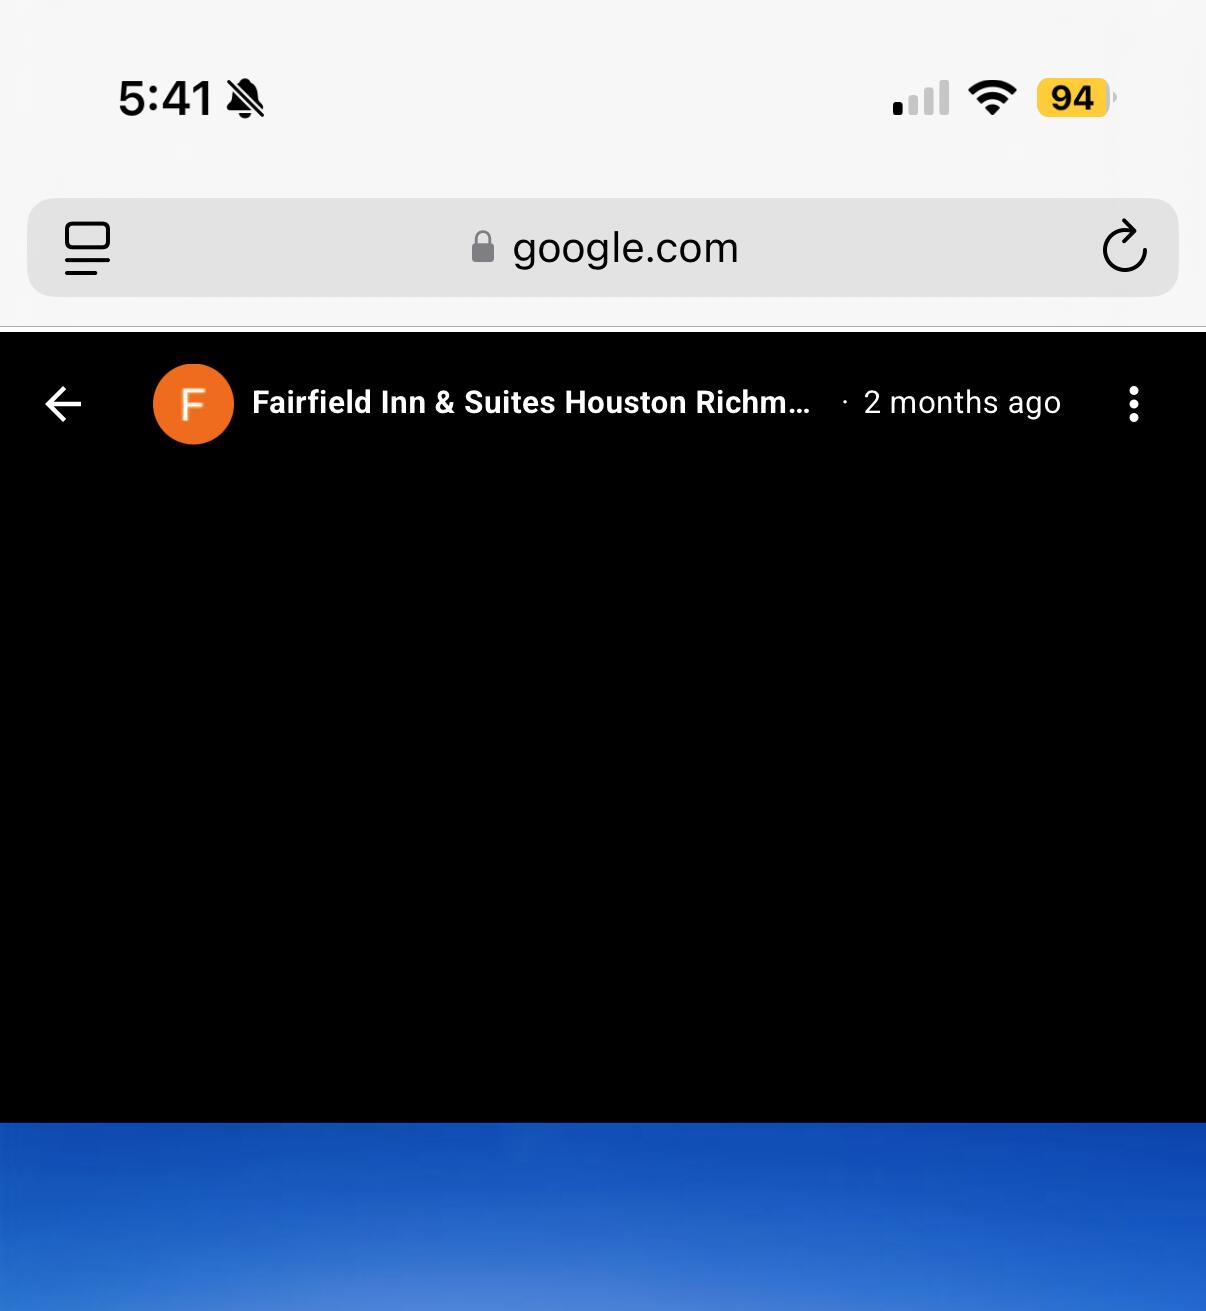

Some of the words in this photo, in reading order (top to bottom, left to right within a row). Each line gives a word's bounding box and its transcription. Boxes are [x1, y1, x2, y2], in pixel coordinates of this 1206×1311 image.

[119, 80, 209, 117] 5:41
[1051, 84, 1095, 111] 94
[512, 230, 738, 271] google.com
[181, 387, 206, 421] F
[253, 388, 371, 415] Fairfield
[381, 389, 426, 414] Inn
[434, 389, 456, 415] &
[464, 389, 556, 415] Suites
[565, 389, 686, 415] Houston
[864, 389, 881, 414] 2
[890, 388, 998, 415] months
[1008, 395, 1061, 422] ago
